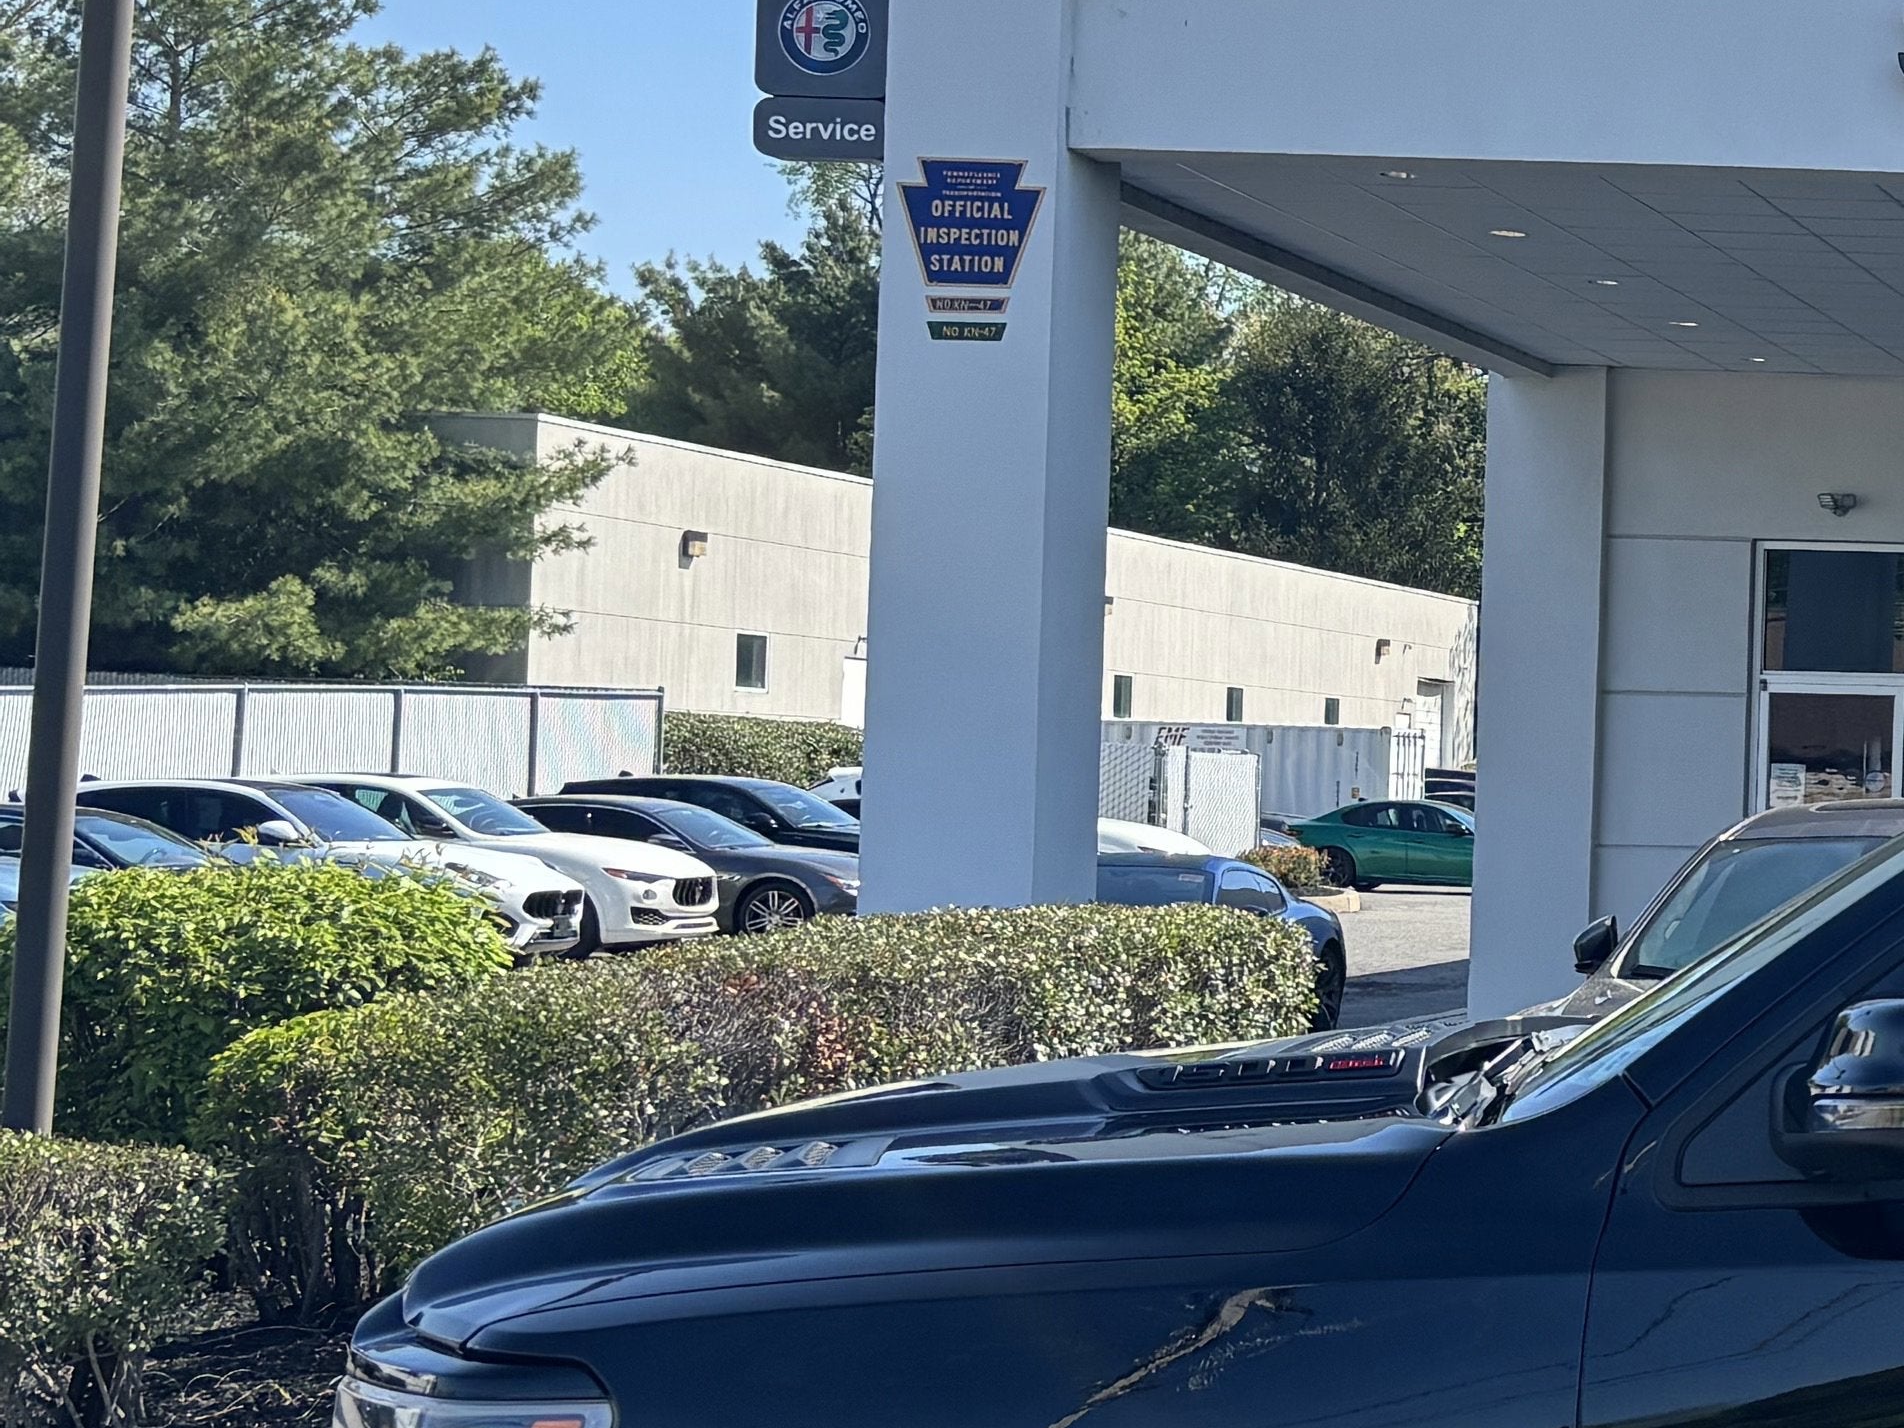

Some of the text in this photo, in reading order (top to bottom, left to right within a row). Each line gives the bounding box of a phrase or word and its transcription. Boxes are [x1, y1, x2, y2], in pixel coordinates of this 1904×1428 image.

[767, 115, 877, 142] Service
[931, 199, 1013, 220] OFFICIAL
[920, 226, 1019, 247] INSPECTION
[929, 254, 1005, 273] STATION
